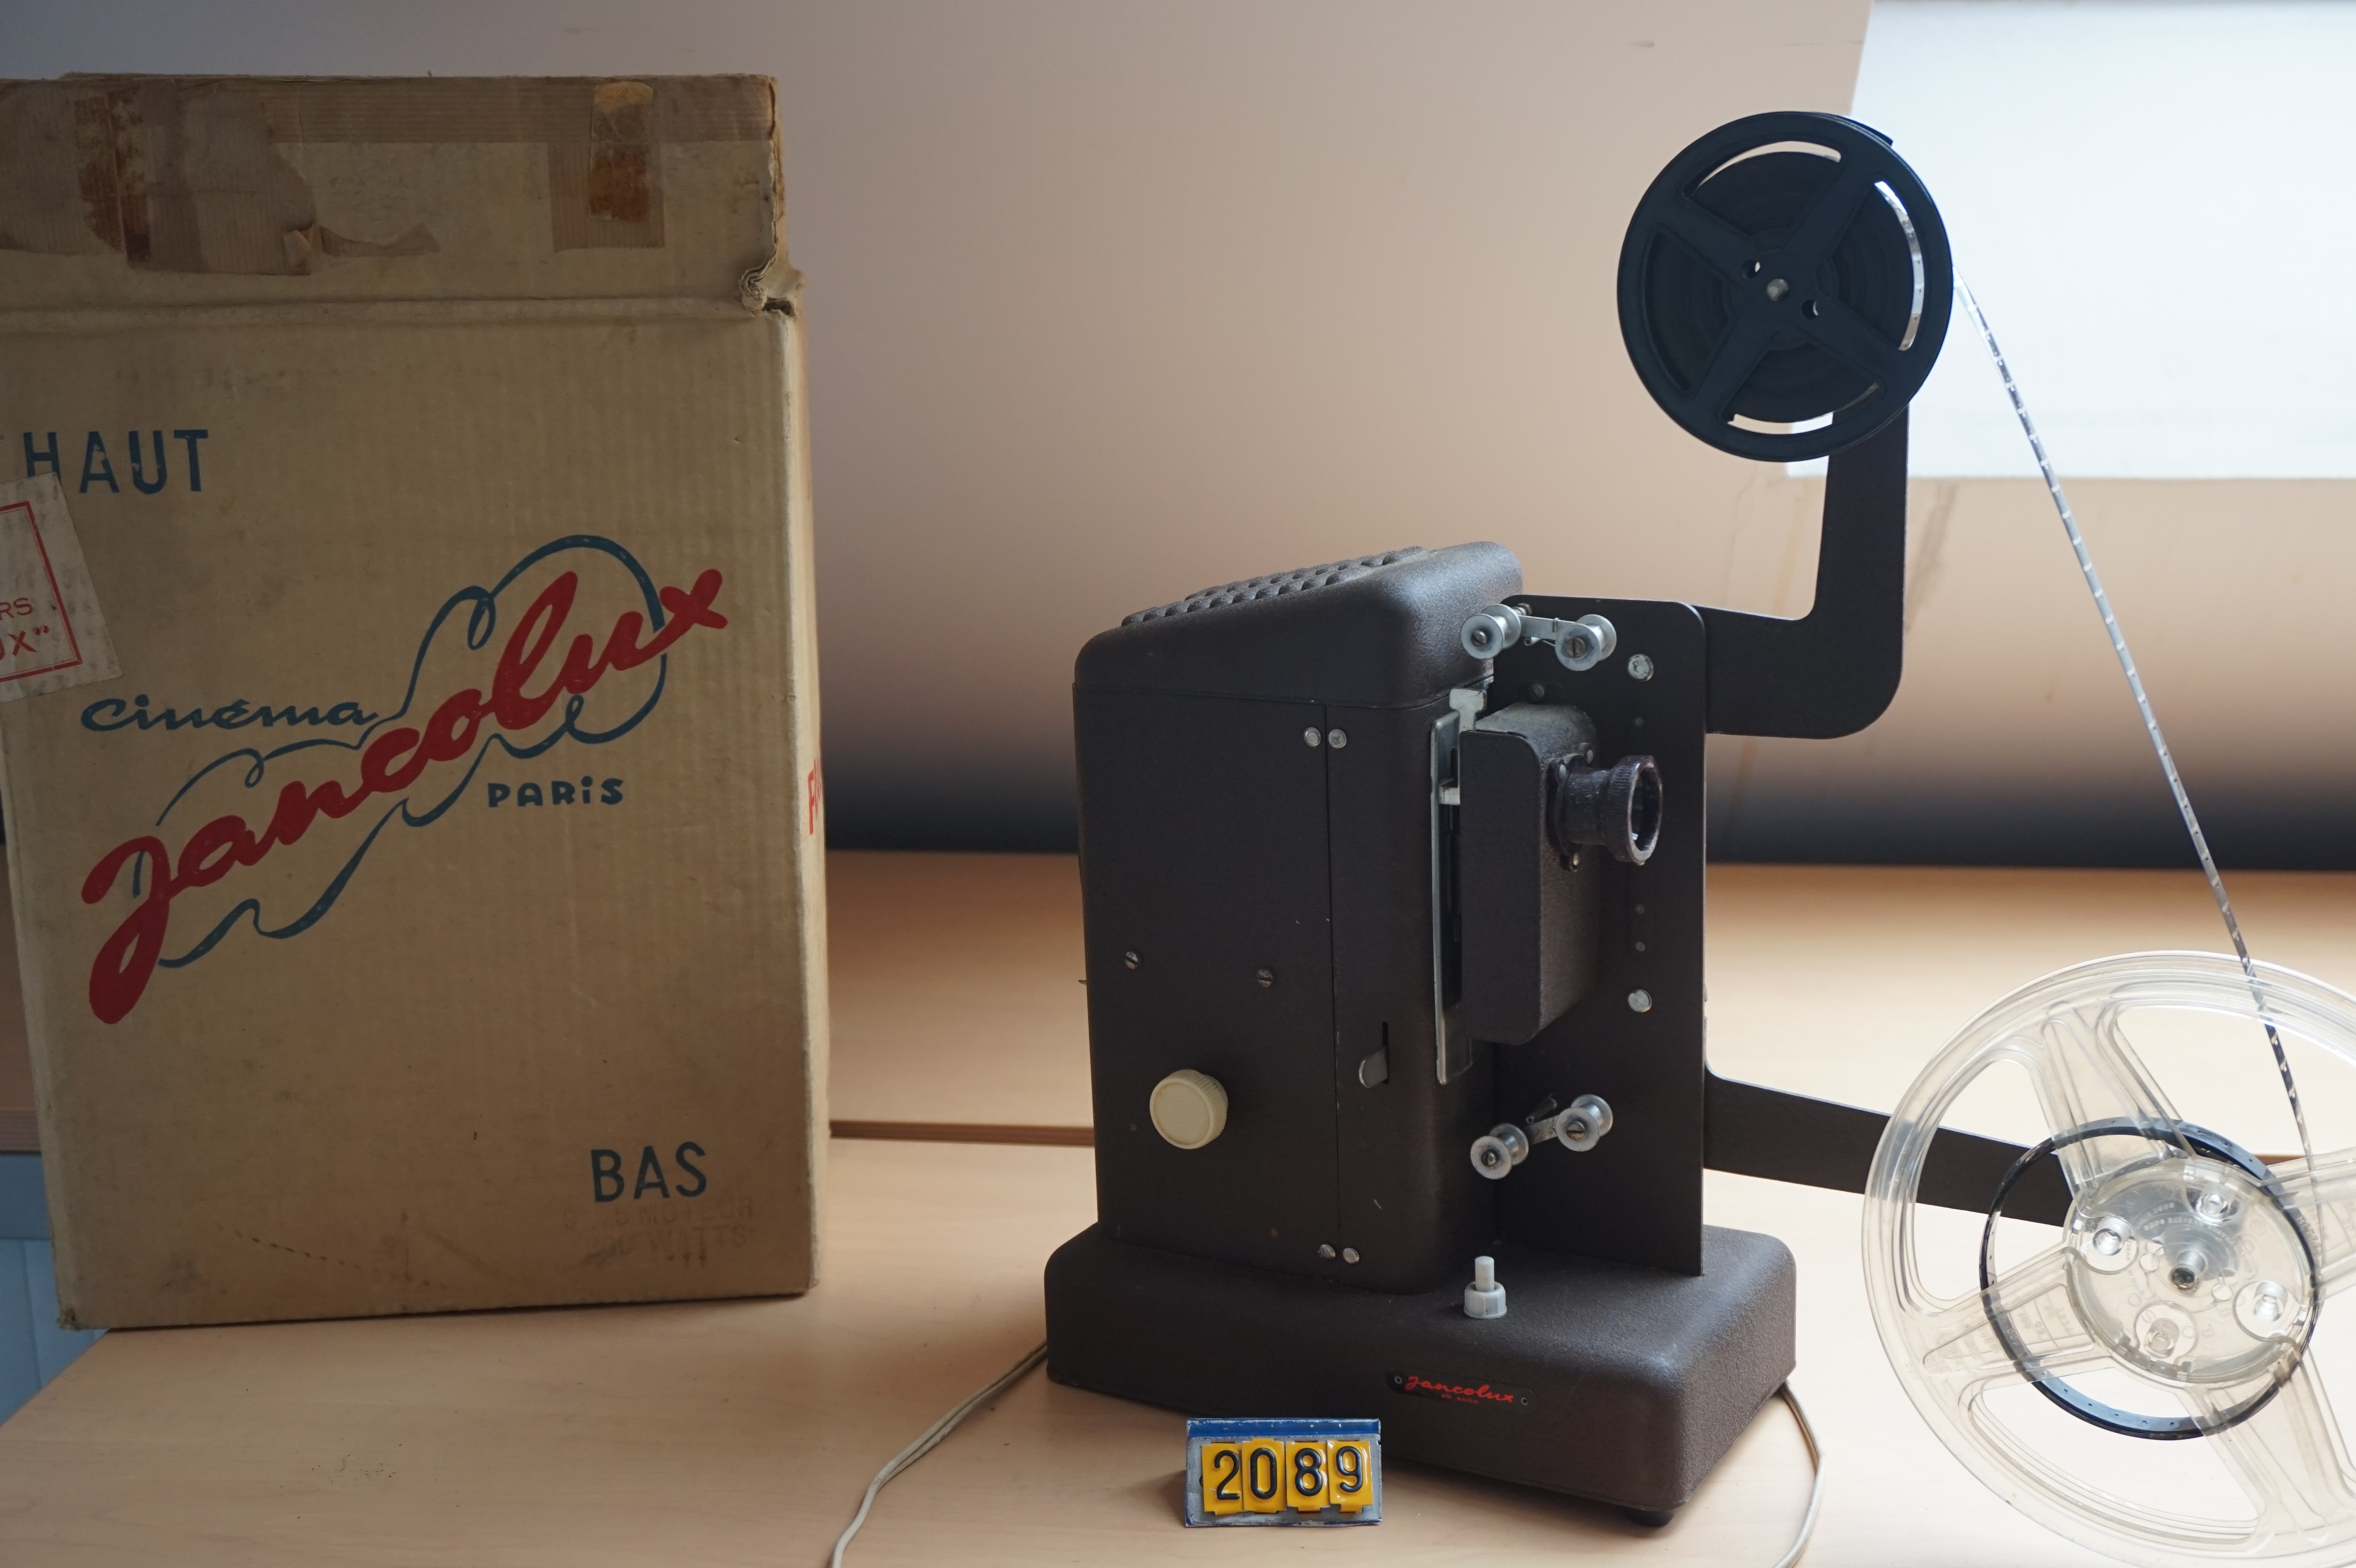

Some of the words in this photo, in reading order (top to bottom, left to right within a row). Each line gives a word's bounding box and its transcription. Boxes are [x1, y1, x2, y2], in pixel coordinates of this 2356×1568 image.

[23, 429, 209, 495] HAUT
[81, 568, 728, 1024] Jancolux
[591, 1141, 707, 1202] BAS
[1405, 1376, 1514, 1403] Jancolux
[1213, 1445, 1362, 1500] 2089
